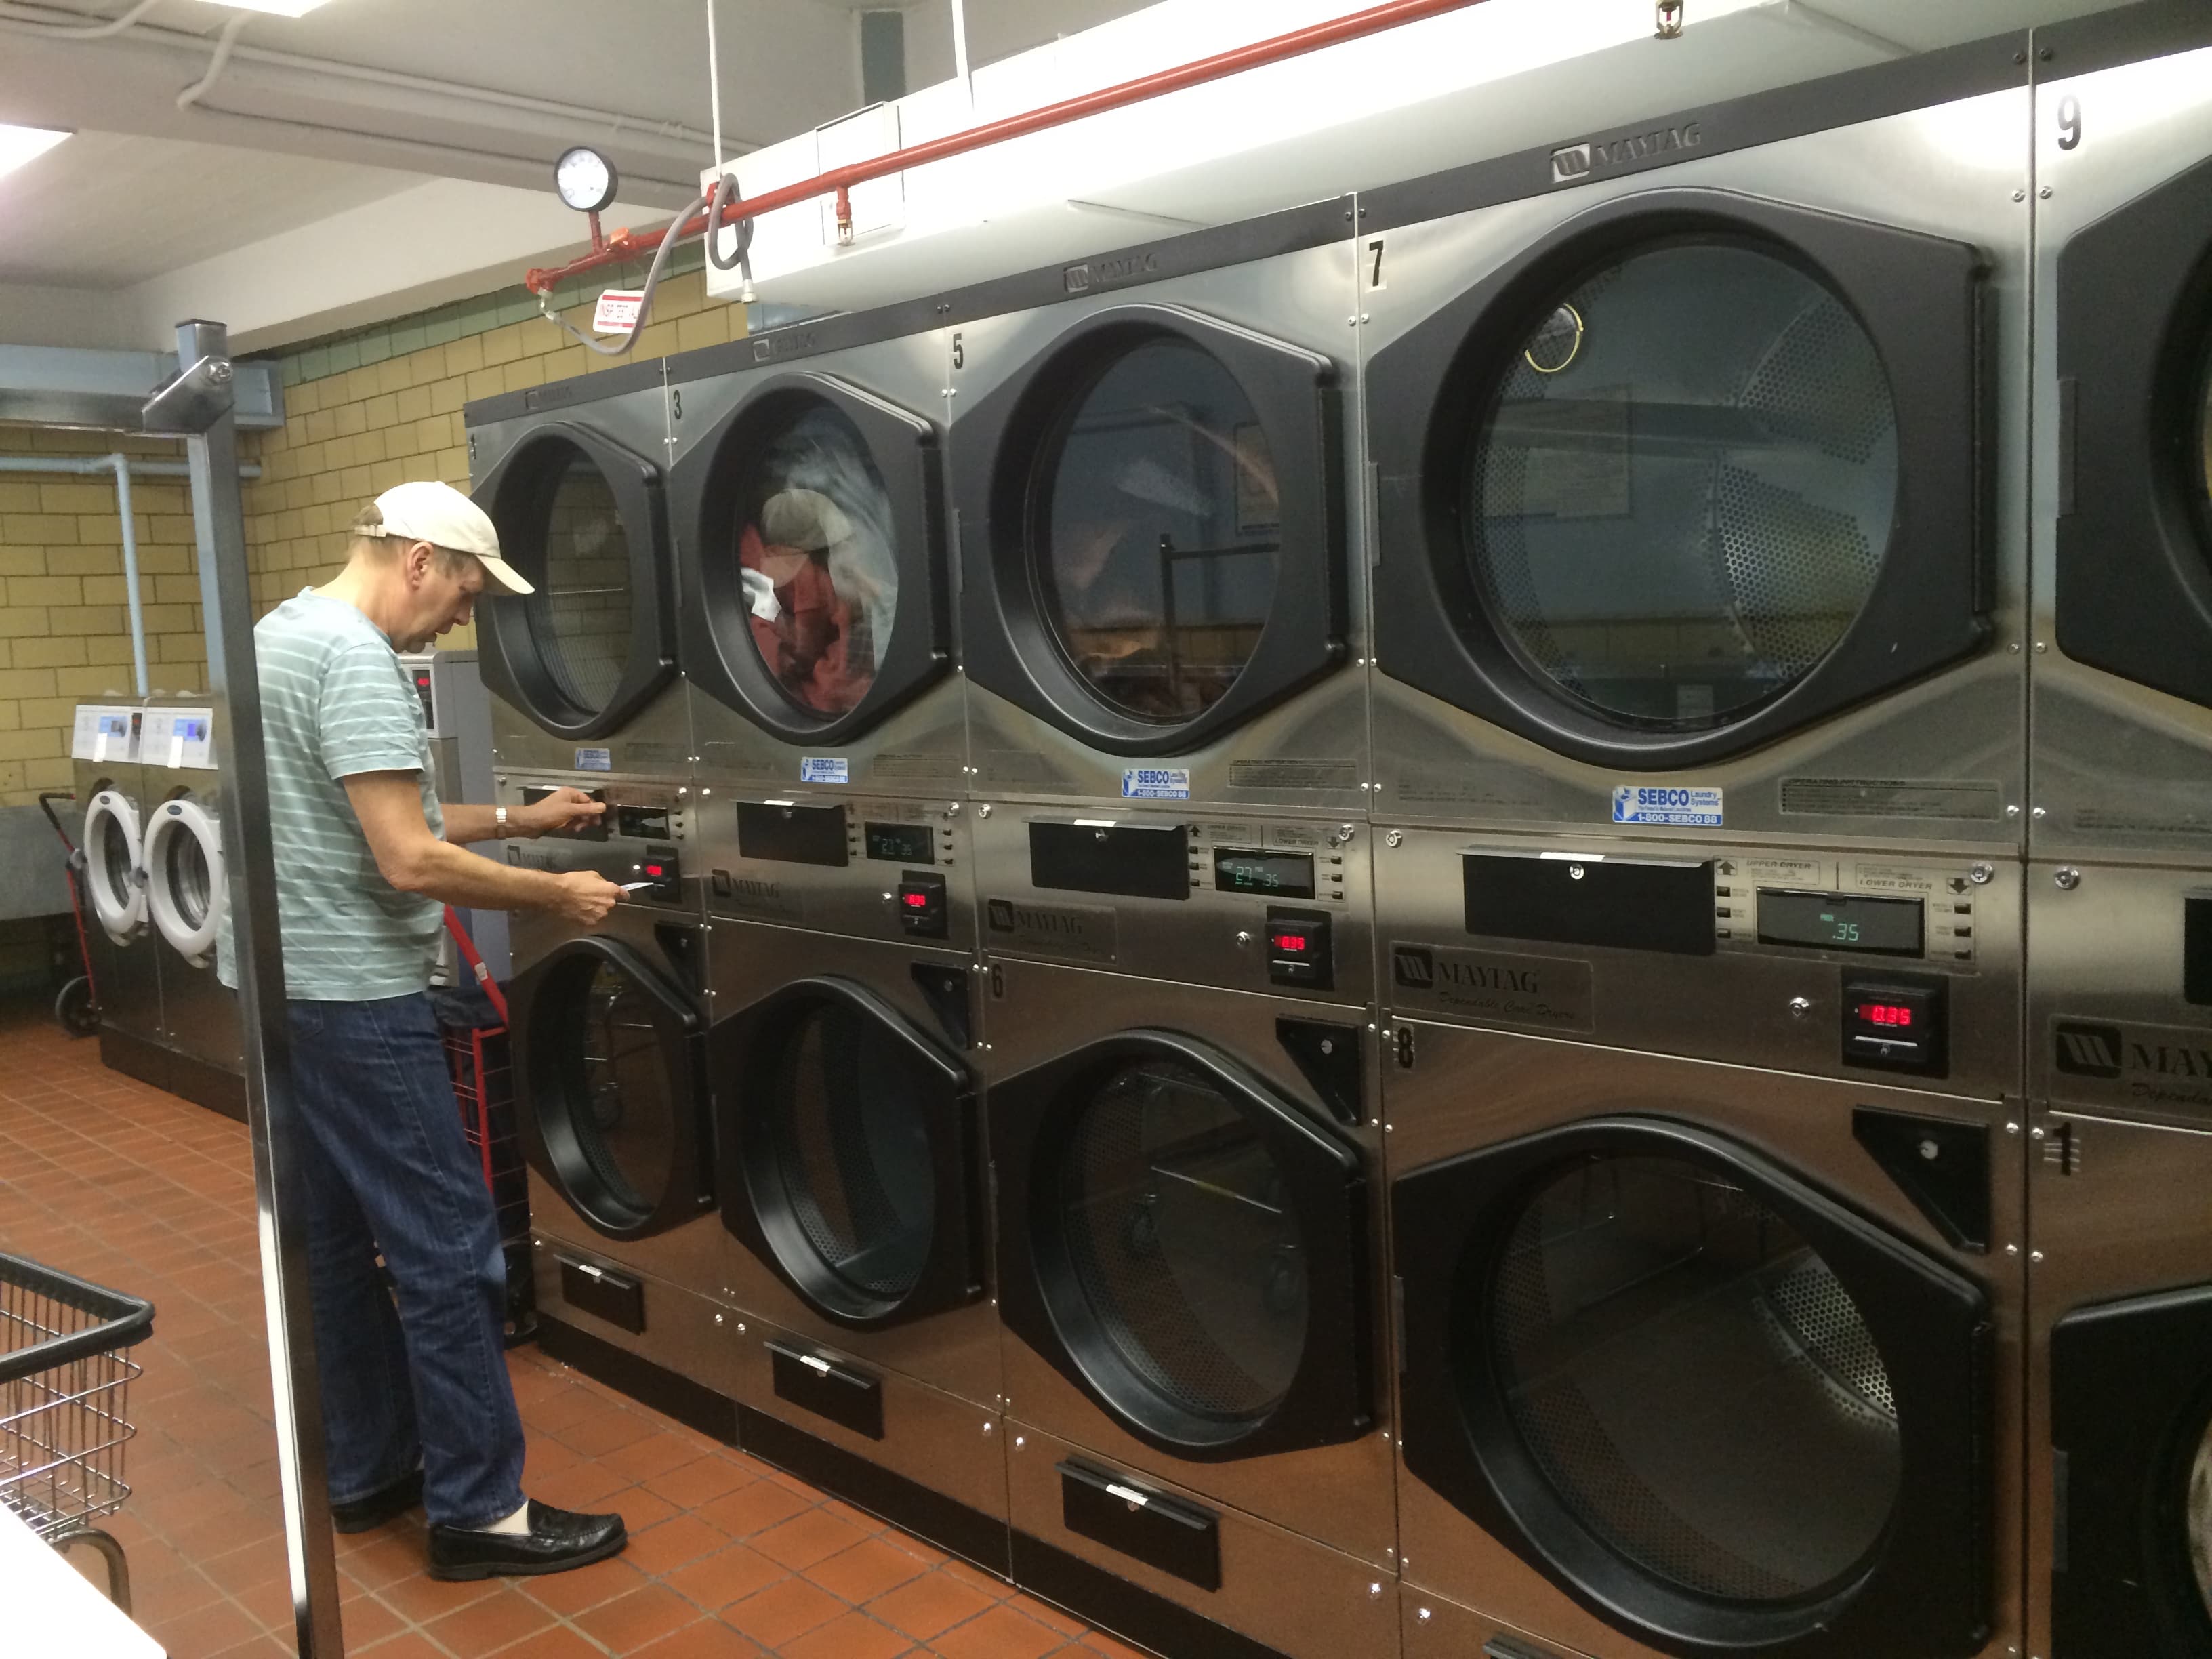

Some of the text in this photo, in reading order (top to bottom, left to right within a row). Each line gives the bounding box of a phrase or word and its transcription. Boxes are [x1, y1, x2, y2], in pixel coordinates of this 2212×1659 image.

[2057, 94, 2081, 150] 9
[1595, 122, 1701, 167] MAYTAG
[1369, 239, 1383, 287] 7
[954, 333, 963, 369] 5
[674, 390, 682, 419] 3
[1138, 770, 1169, 784] SEBCO
[1638, 788, 1689, 806] SEBCO
[1691, 790, 1717, 799] Laundry
[1637, 813, 1717, 824] 1-800-SEBCO 88
[1235, 866, 1252, 881] 27
[1746, 859, 1811, 869] UPPER DRYER
[1860, 879, 1933, 890] LOWER DRYER
[1015, 909, 1084, 934] MAYTAG
[1832, 923, 1859, 941] .35
[992, 964, 1004, 998] 6
[1437, 962, 1538, 994] MAYTAG
[1397, 1026, 1414, 1069] 8
[2053, 1122, 2071, 1176] 1
